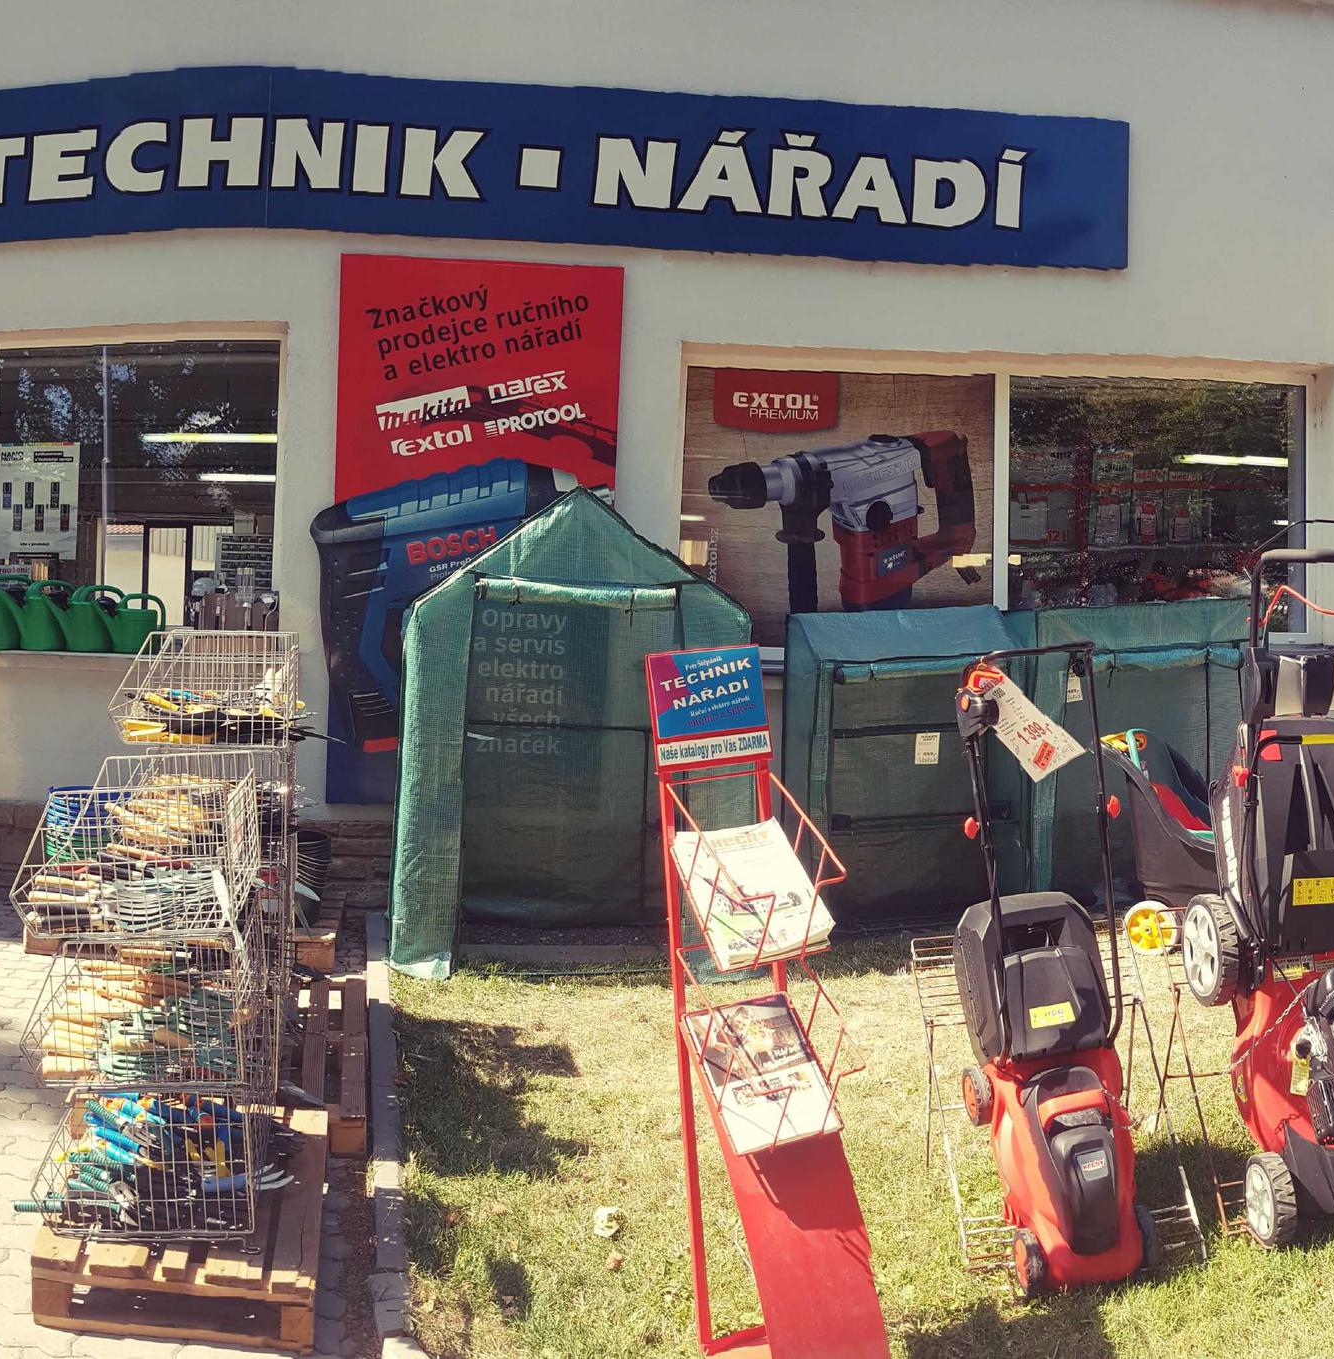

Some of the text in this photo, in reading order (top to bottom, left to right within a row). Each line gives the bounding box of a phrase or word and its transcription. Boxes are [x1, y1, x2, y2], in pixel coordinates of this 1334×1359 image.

[593, 130, 1030, 229] NÁŘADÍ
[366, 284, 488, 329] Značkový
[377, 295, 589, 360] prodejce ručního
[383, 318, 582, 381] a elektro nářadí
[488, 371, 568, 402] narex
[496, 403, 586, 435] PROTOOL
[750, 408, 819, 420] PREMIUM
[406, 526, 497, 565] BOSCH
[429, 563, 448, 573] GSR
[482, 609, 567, 633] Opravy
[473, 635, 565, 655] a servis
[478, 658, 564, 679] elektro
[660, 657, 752, 691] TECHNIK
[685, 663, 697, 671] Petr
[486, 683, 563, 704] nářadí
[672, 676, 749, 710] NÁŘADÍ
[492, 706, 560, 730] všech
[474, 734, 560, 755] značek
[660, 734, 769, 760] Naše katalogy pro Vás ZDARMA
